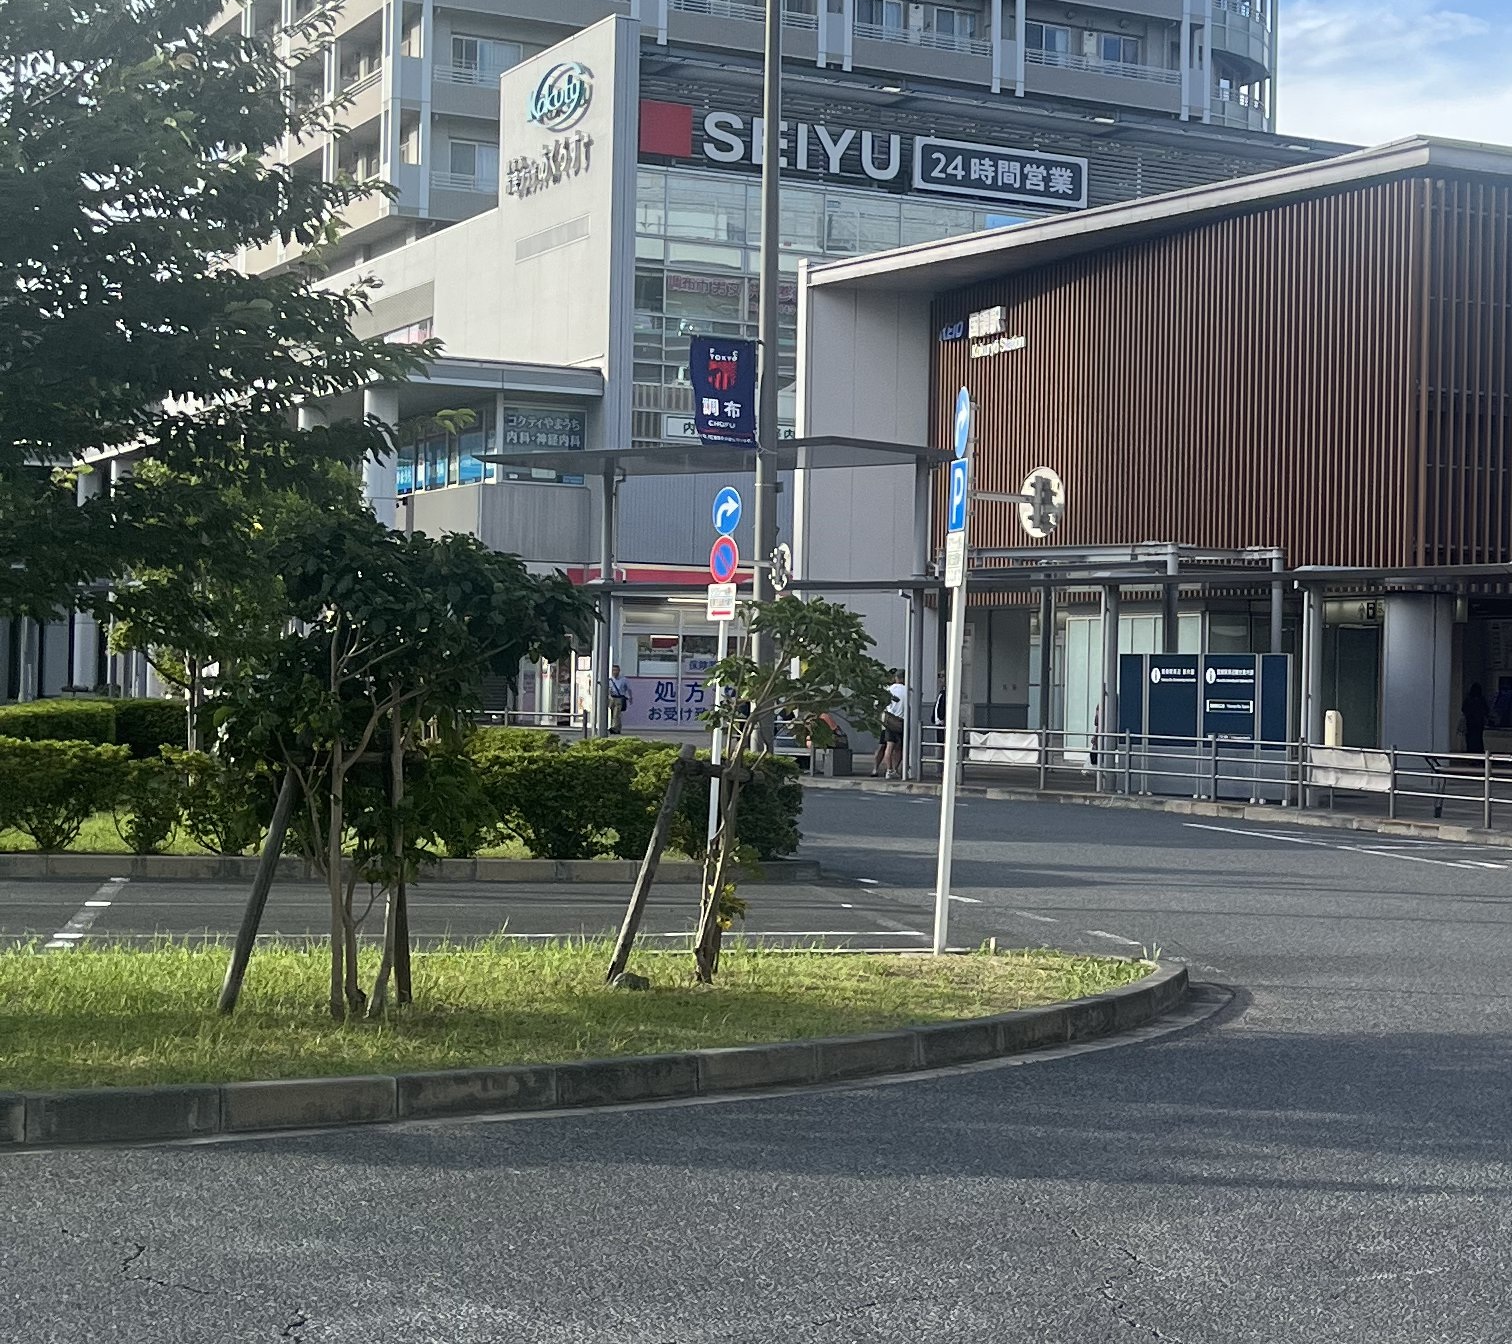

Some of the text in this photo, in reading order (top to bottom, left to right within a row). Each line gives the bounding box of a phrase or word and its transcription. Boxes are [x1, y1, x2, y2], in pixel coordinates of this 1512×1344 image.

[702, 111, 901, 182] SEIYU
[930, 152, 1075, 196] 24時間営業
[702, 397, 741, 419] 調布
[952, 467, 964, 524] P
